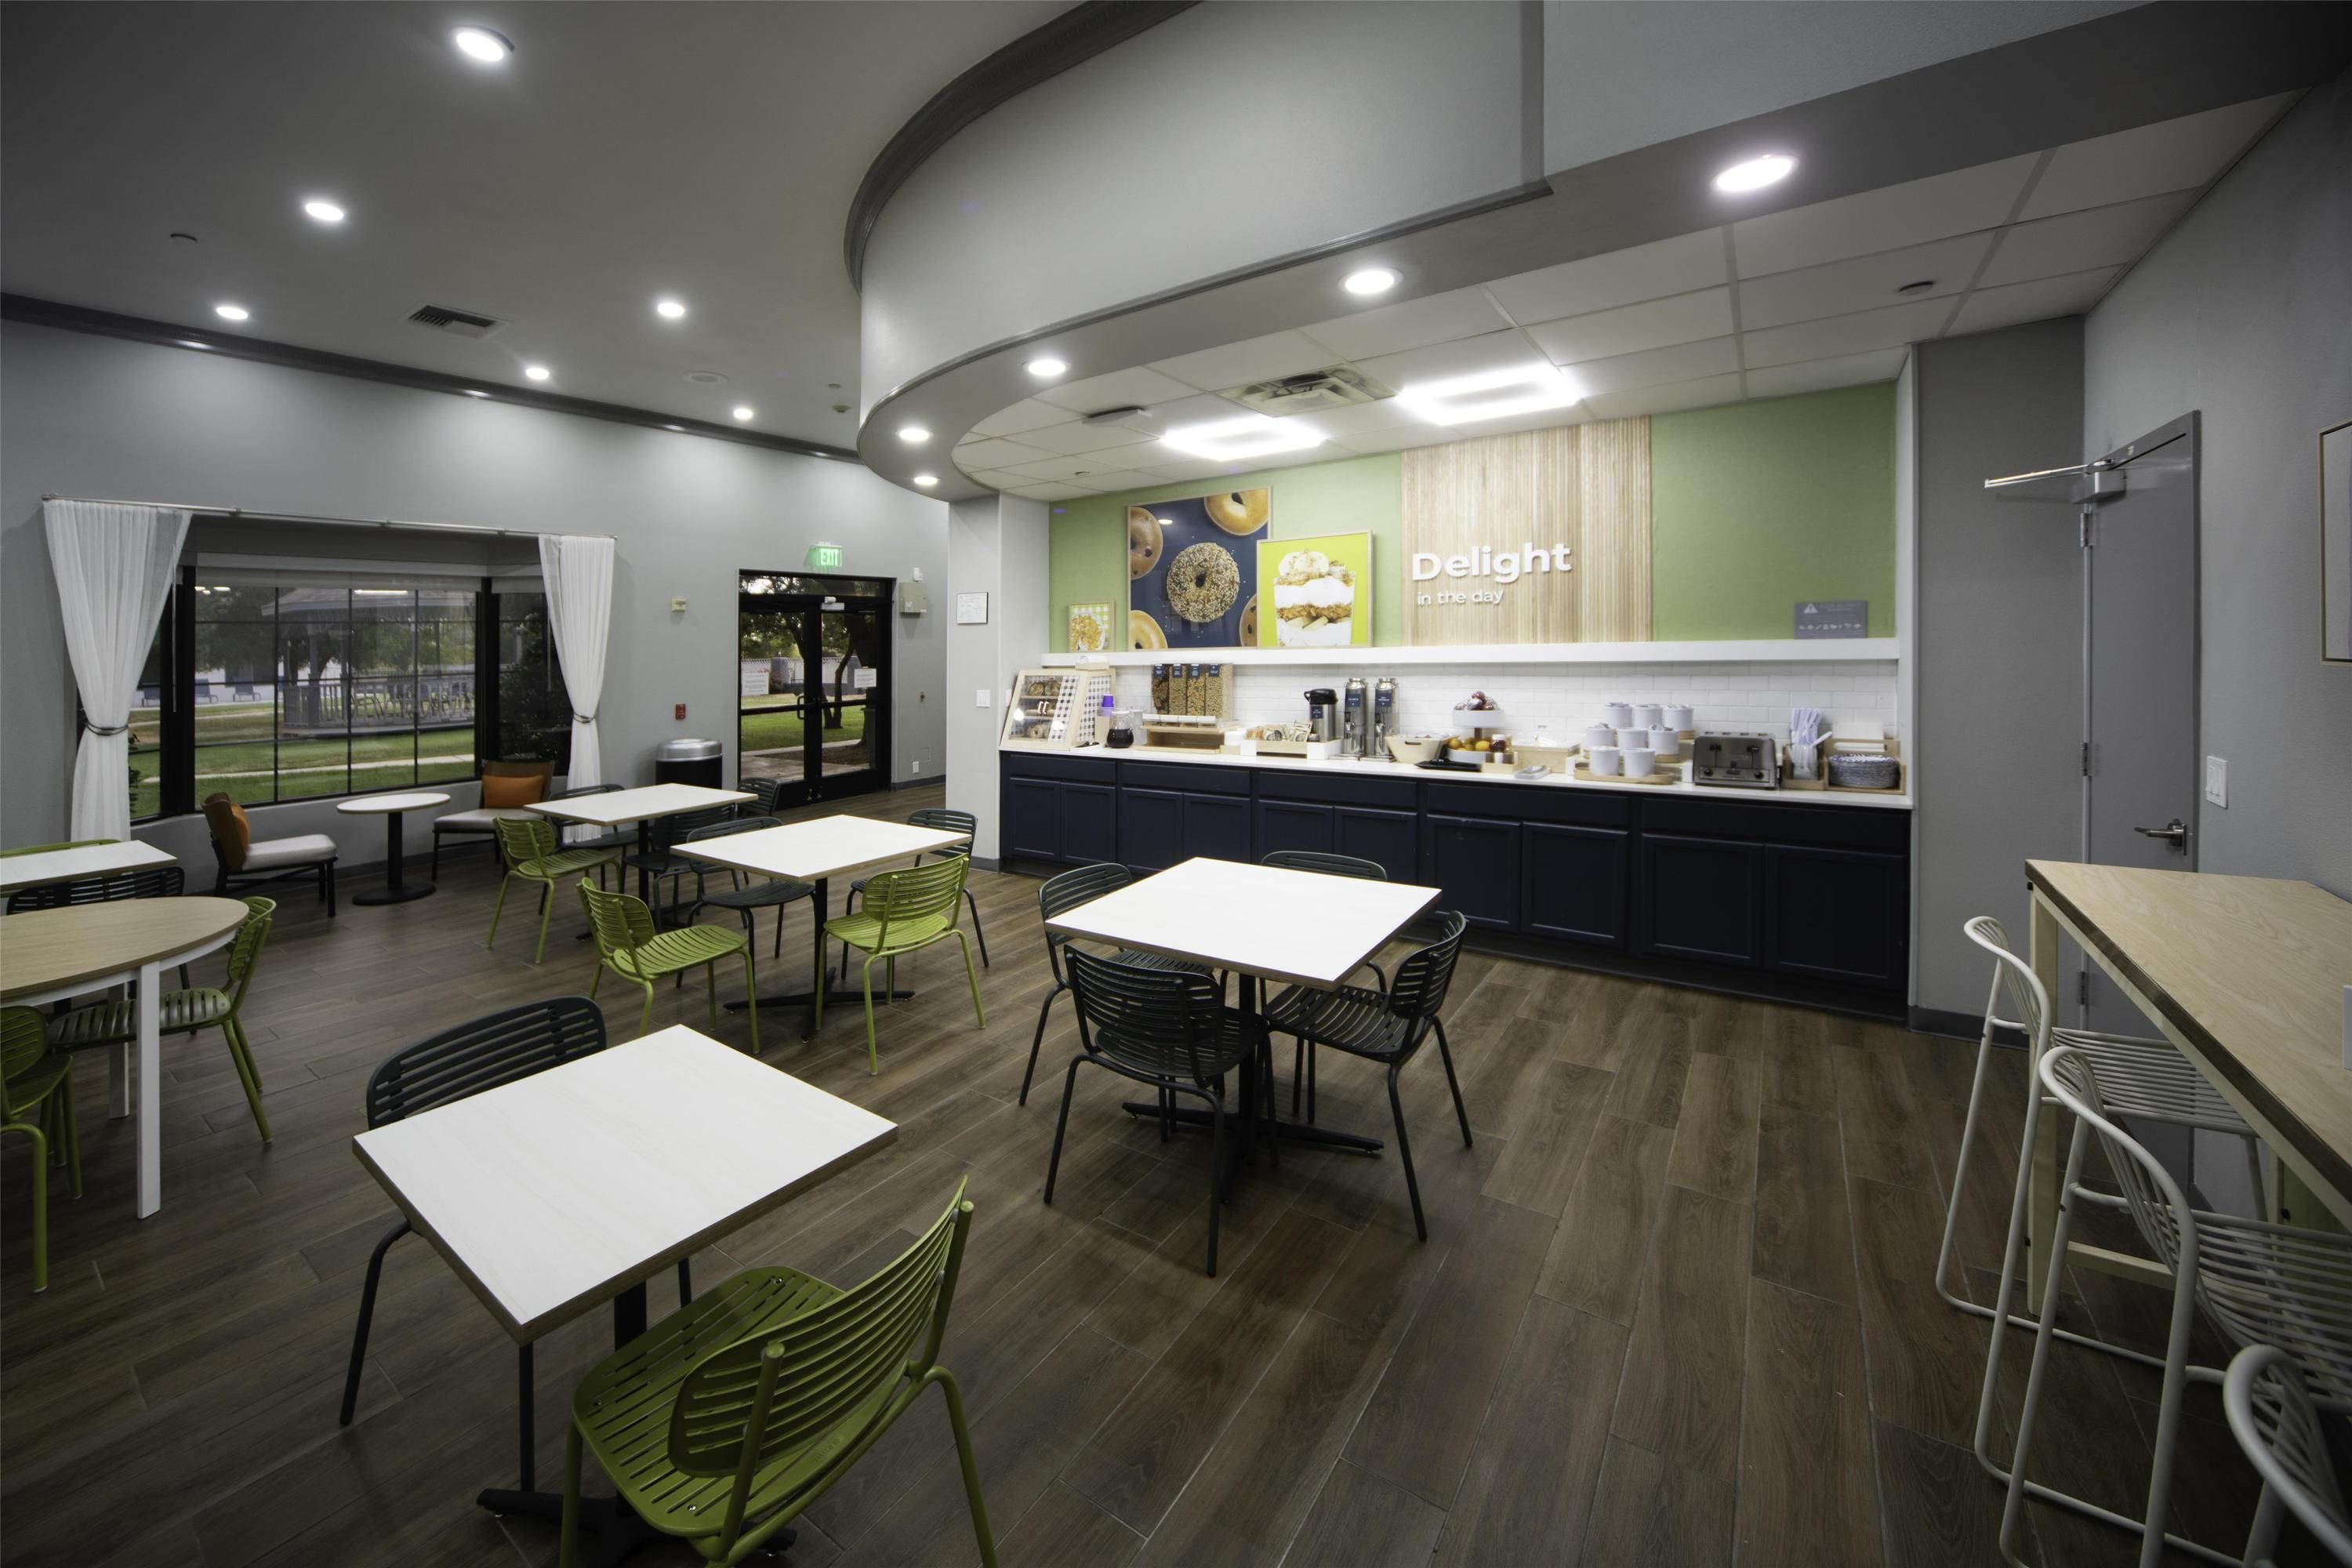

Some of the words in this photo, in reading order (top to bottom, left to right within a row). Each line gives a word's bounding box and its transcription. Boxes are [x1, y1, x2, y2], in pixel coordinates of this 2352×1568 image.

[820, 548, 840, 566] EXIT
[1412, 542, 1572, 583] Delight
[1417, 592, 1432, 605] in
[1438, 590, 1467, 604] the
[1472, 589, 1505, 604] day
